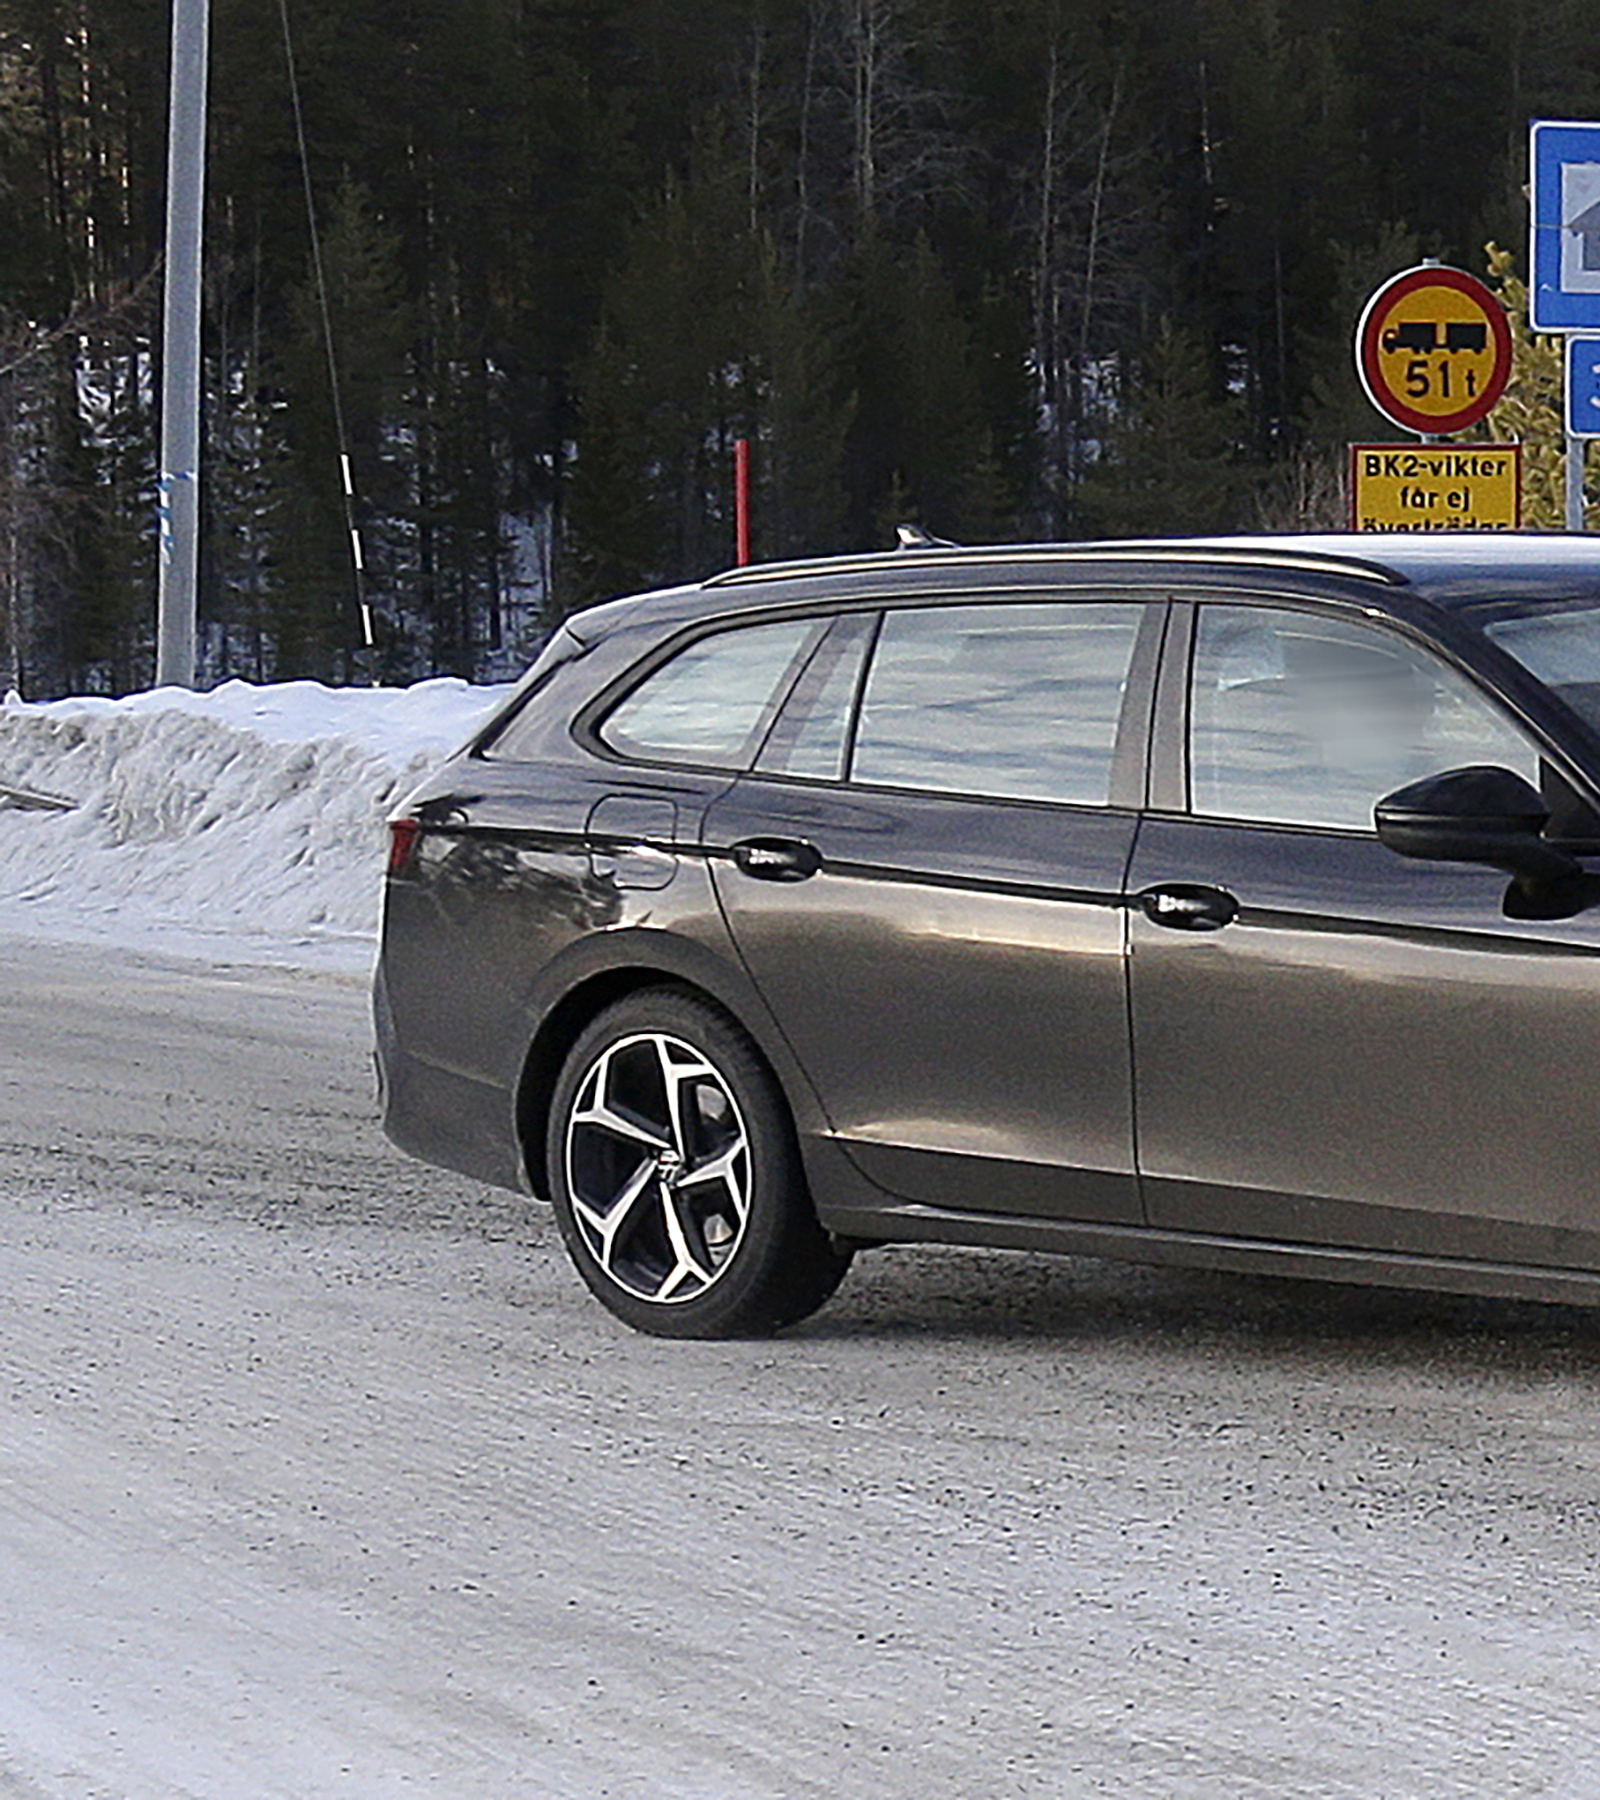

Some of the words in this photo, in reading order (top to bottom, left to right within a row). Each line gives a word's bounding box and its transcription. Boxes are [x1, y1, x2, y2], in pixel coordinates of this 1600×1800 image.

[1405, 360, 1449, 398] 51
[1465, 369, 1476, 397] t
[1365, 455, 1507, 477] BK2-vikter
[1401, 486, 1438, 508] får
[1447, 486, 1470, 512] ej
